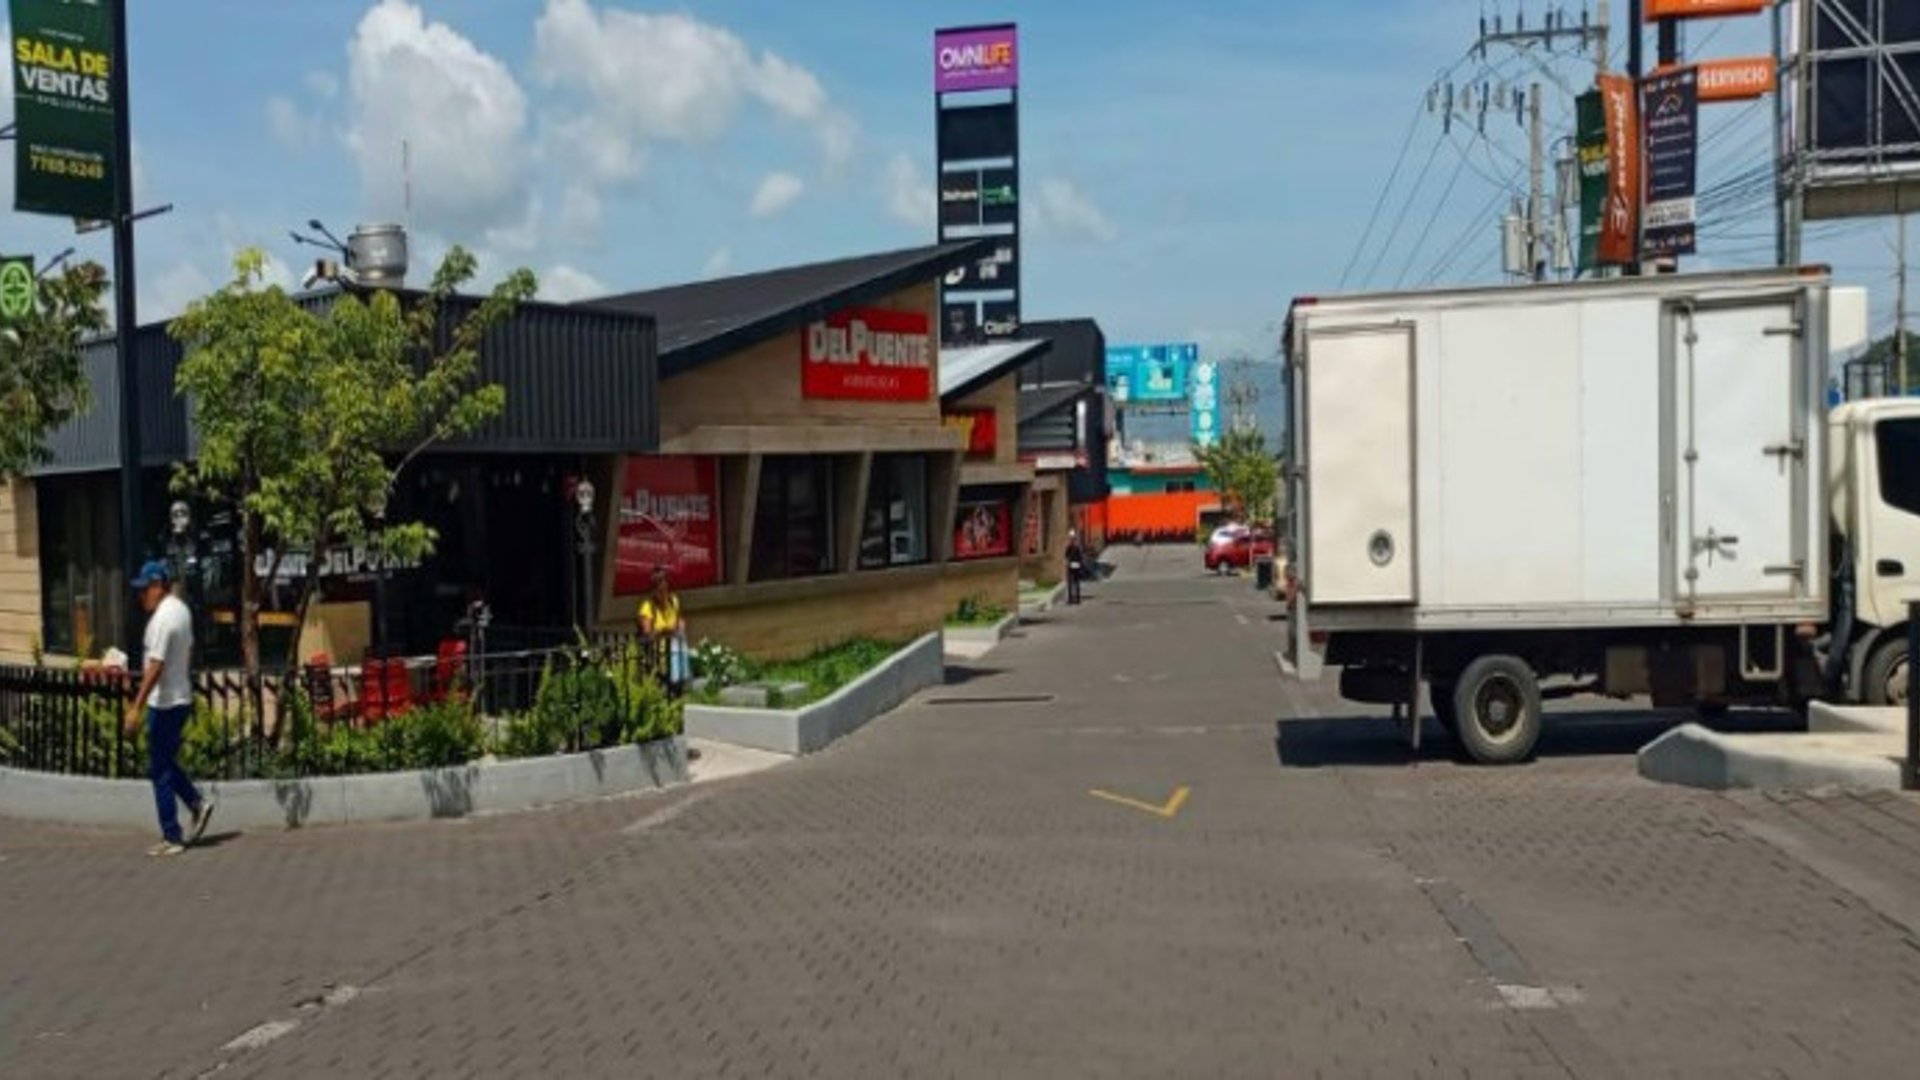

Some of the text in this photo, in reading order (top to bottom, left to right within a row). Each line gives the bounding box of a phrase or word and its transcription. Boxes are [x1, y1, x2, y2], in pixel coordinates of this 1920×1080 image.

[16, 38, 109, 78] SALA DE
[940, 43, 1011, 70] OMNILIFE
[20, 66, 109, 103] VENTAS
